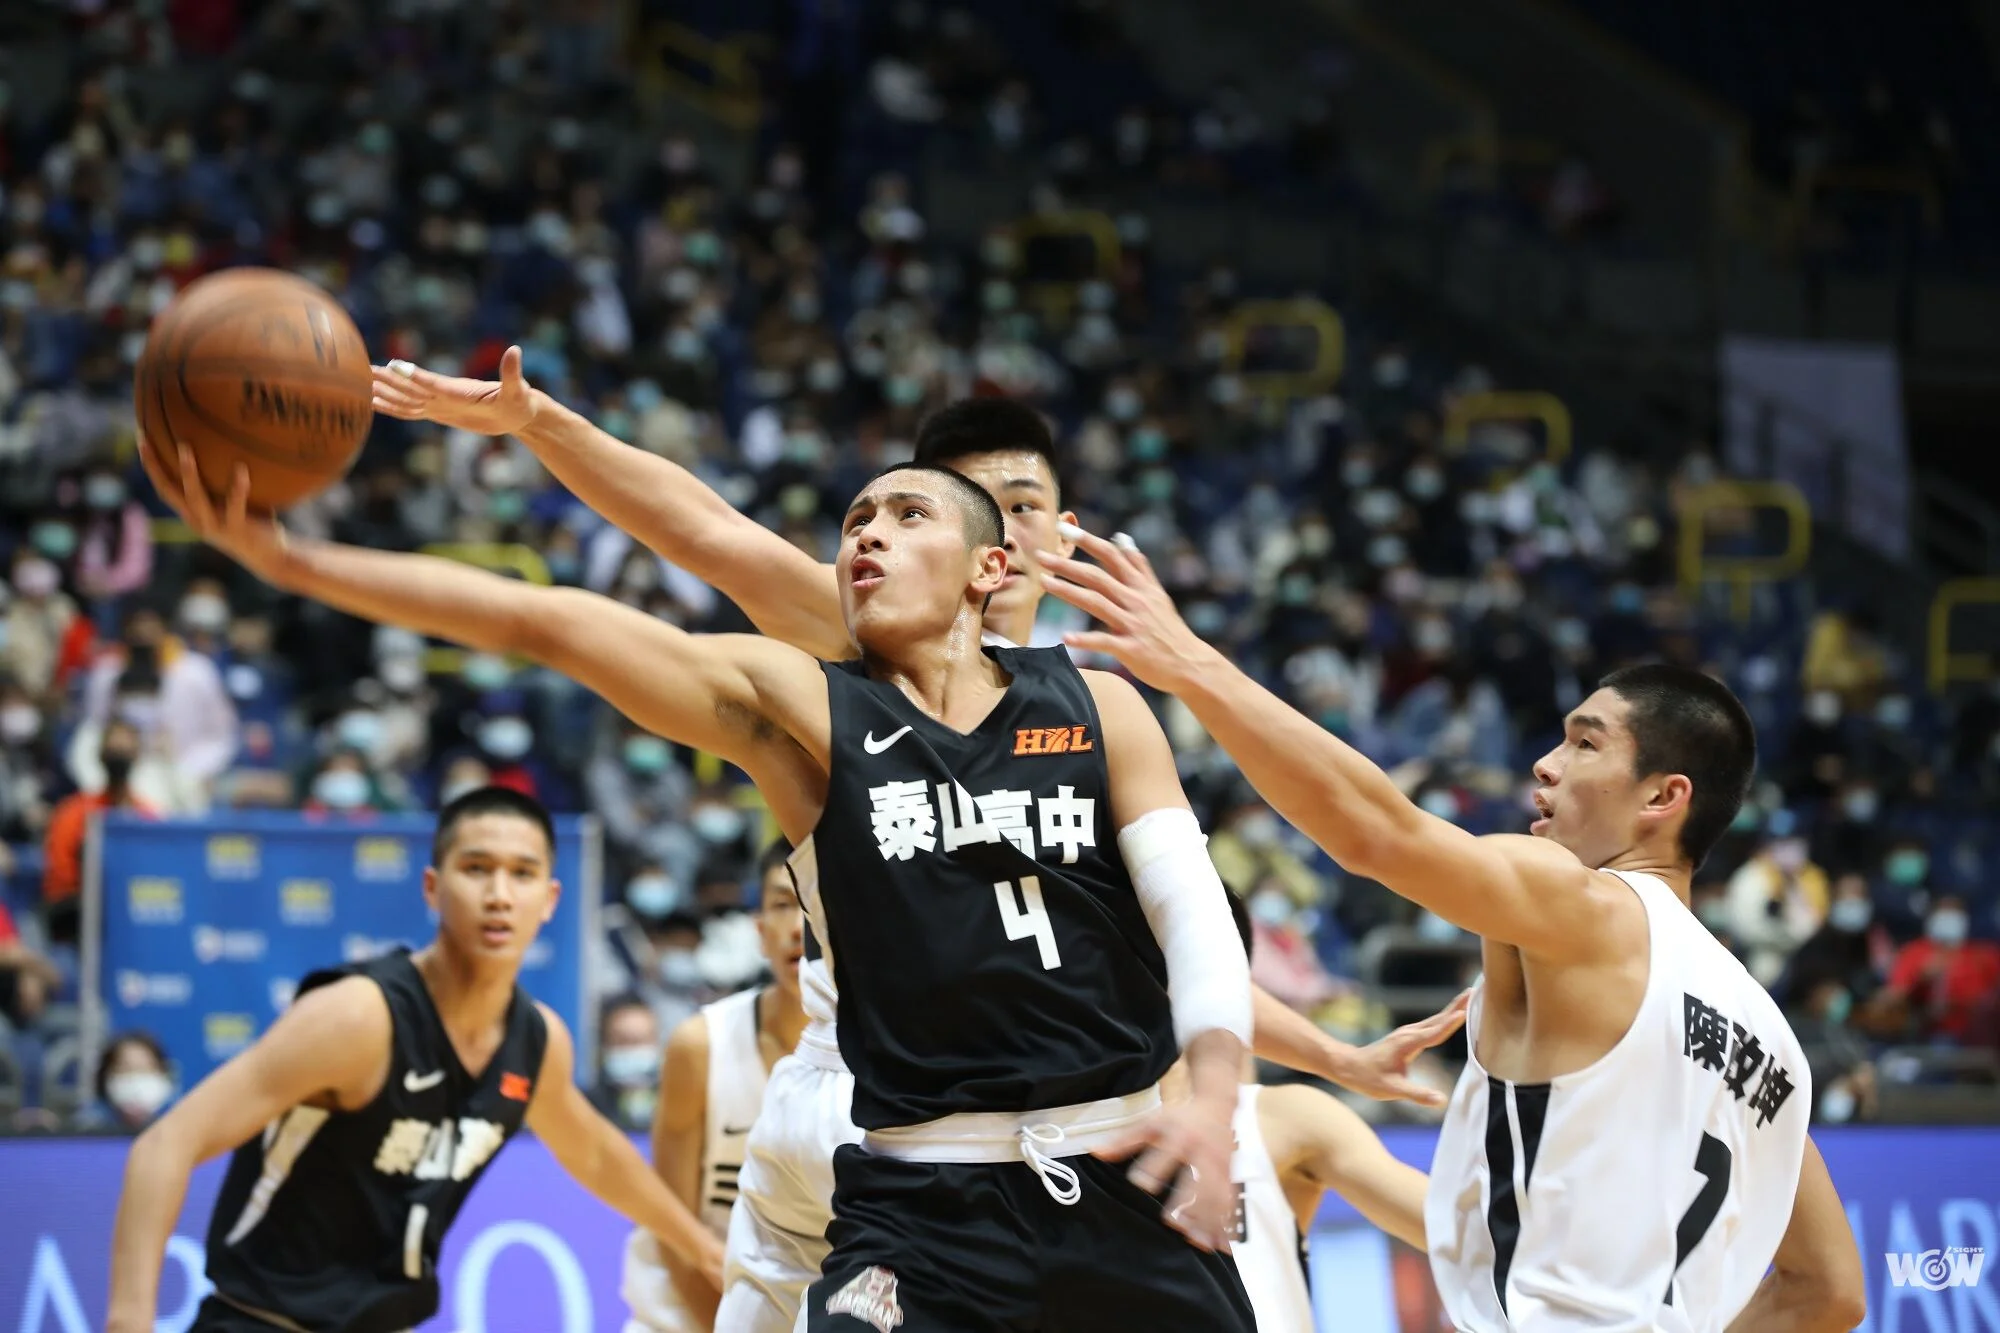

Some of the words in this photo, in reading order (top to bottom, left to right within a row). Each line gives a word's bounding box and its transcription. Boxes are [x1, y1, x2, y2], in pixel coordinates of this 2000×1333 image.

[868, 779, 1096, 863] 泰山高中
[994, 875, 1061, 970] 4
